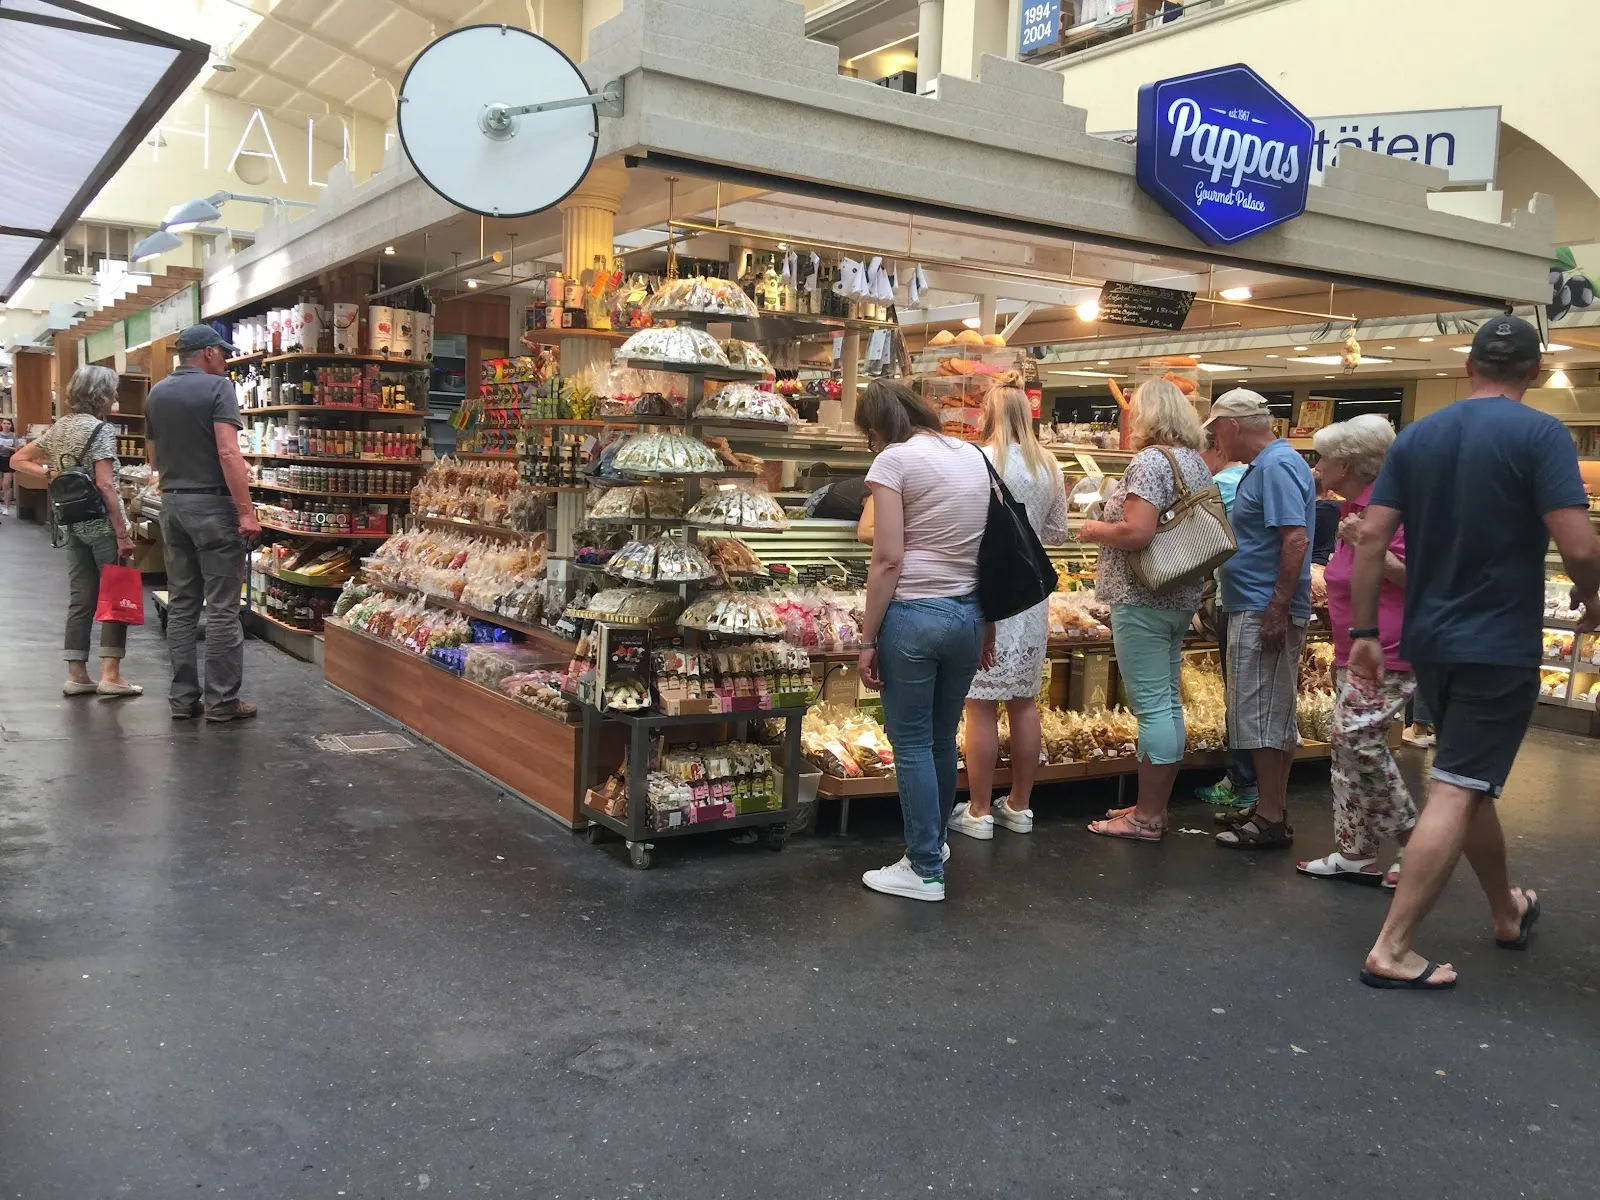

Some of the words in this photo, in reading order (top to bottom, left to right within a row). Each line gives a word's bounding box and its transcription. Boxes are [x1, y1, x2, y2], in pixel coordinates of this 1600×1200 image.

[1024, 1, 1058, 26] 1994-
[1022, 20, 1052, 46] 2004
[1238, 108, 1250, 122] 1967
[1167, 97, 1300, 188] Pappas
[1195, 180, 1235, 206] Gourmet
[1235, 189, 1266, 213] Palace
